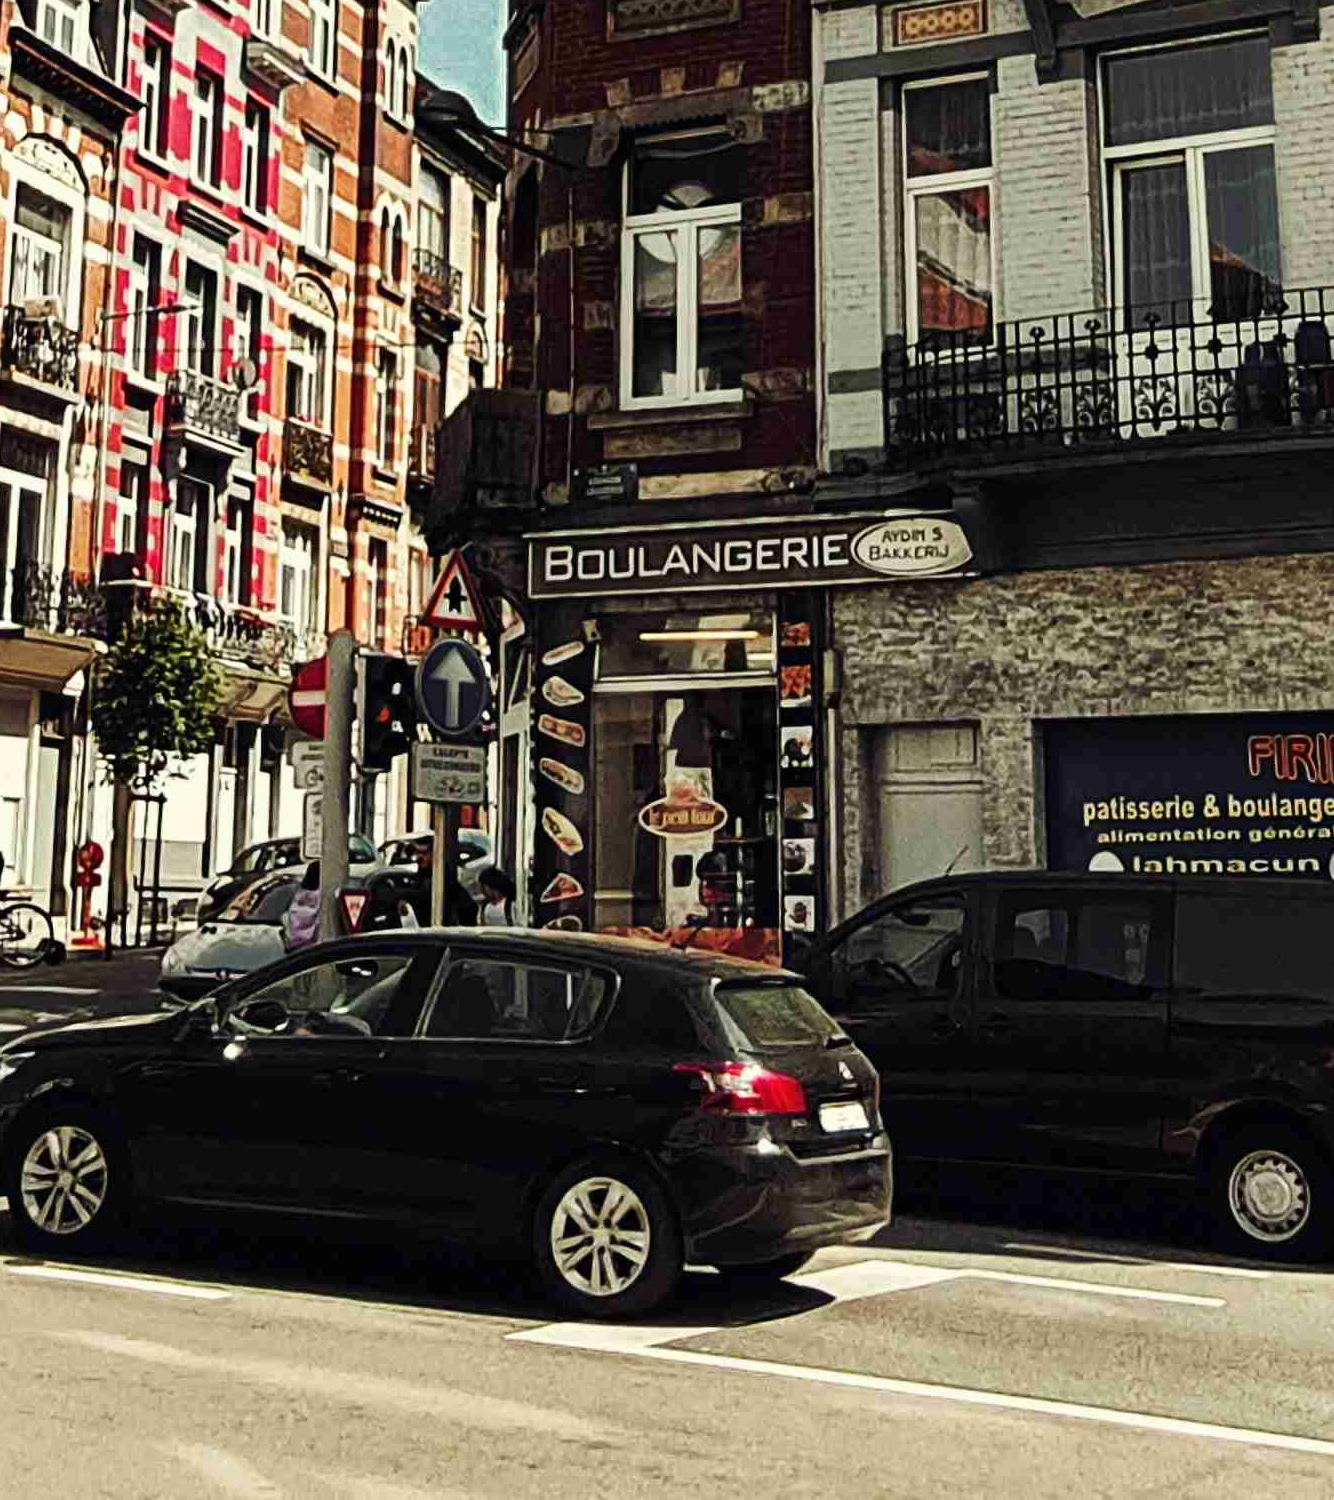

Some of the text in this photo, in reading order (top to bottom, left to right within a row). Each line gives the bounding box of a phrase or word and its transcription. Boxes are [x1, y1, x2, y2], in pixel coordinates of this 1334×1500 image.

[544, 532, 849, 582] BOULANGERIE
[868, 543, 949, 562] BAKKERIJ
[1082, 796, 1196, 827] patisserie
[1202, 793, 1220, 819] &
[1097, 826, 1242, 844] alimentation
[1132, 855, 1321, 874] lahmacun
